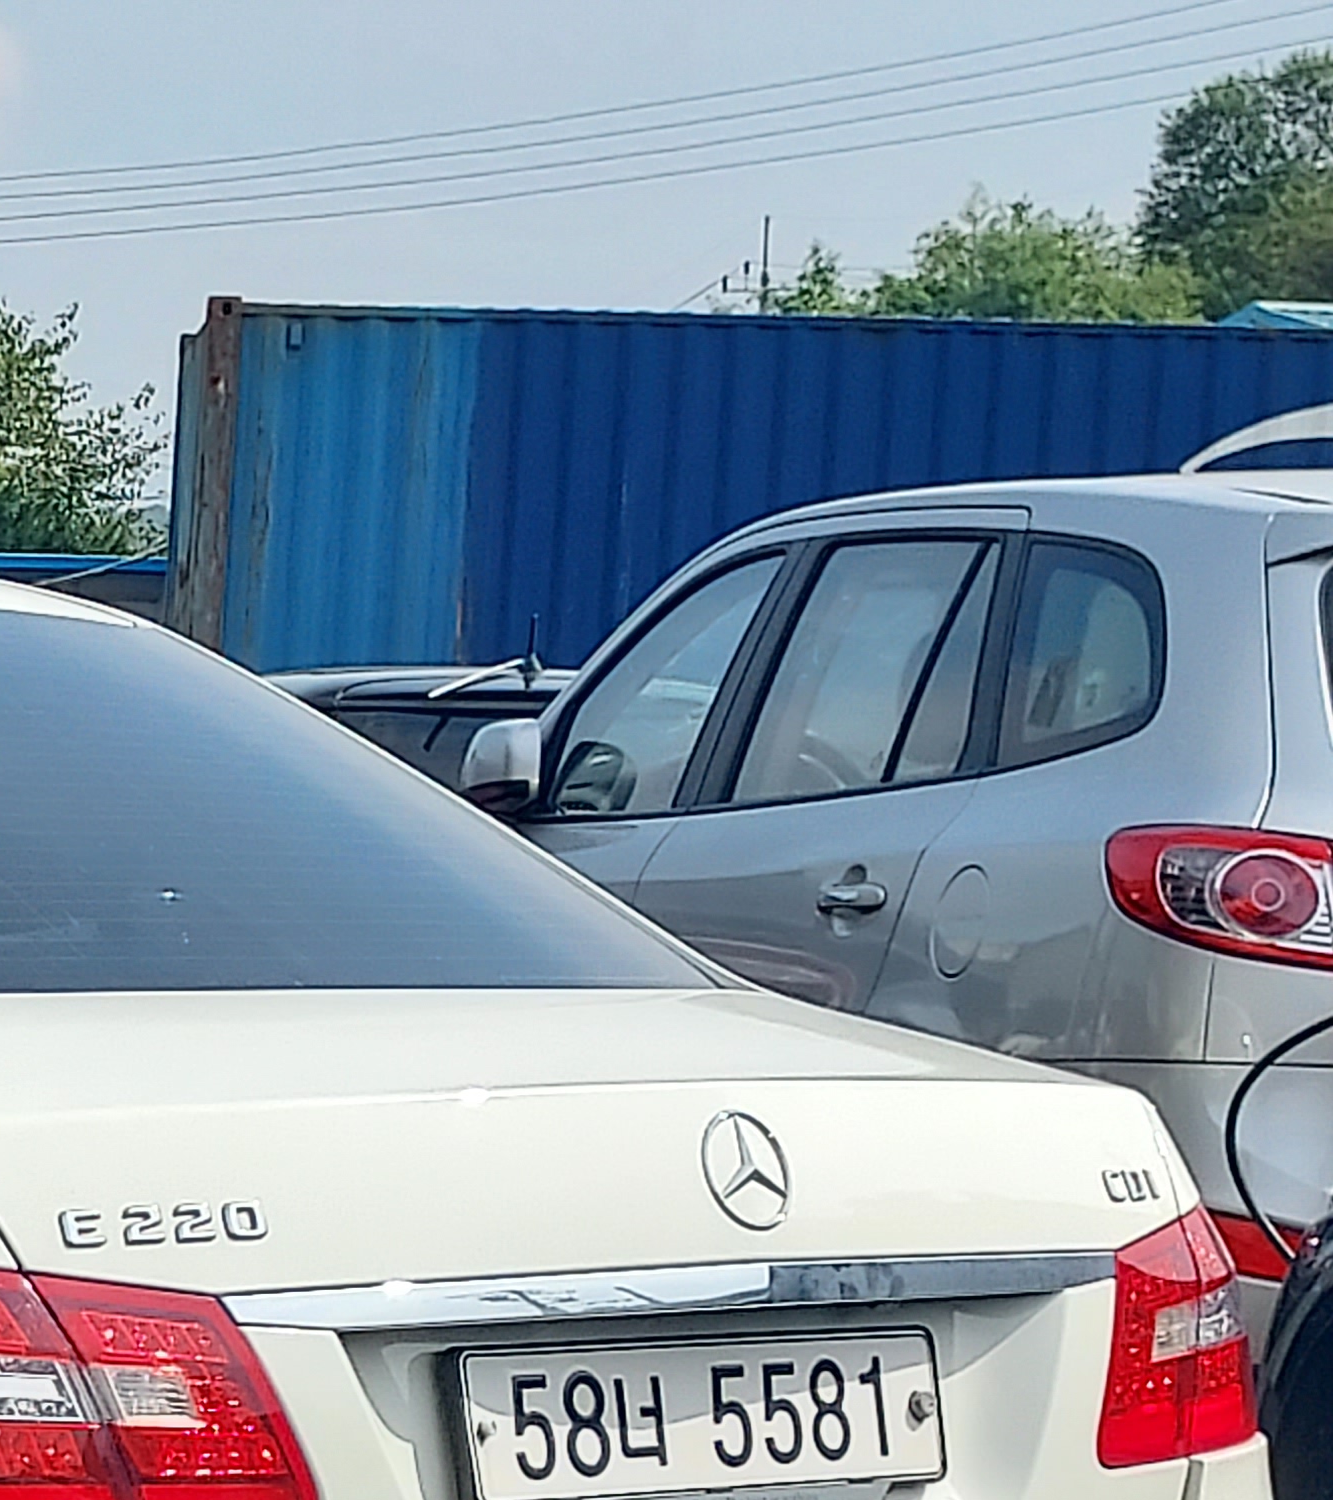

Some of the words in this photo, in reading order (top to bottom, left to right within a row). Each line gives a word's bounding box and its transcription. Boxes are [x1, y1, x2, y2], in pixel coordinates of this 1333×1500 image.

[1100, 1168, 1161, 1203] CDI
[57, 1208, 108, 1250] E
[120, 1199, 269, 1247] 220
[511, 1369, 668, 1481] 58너
[709, 1355, 890, 1468] 5581
